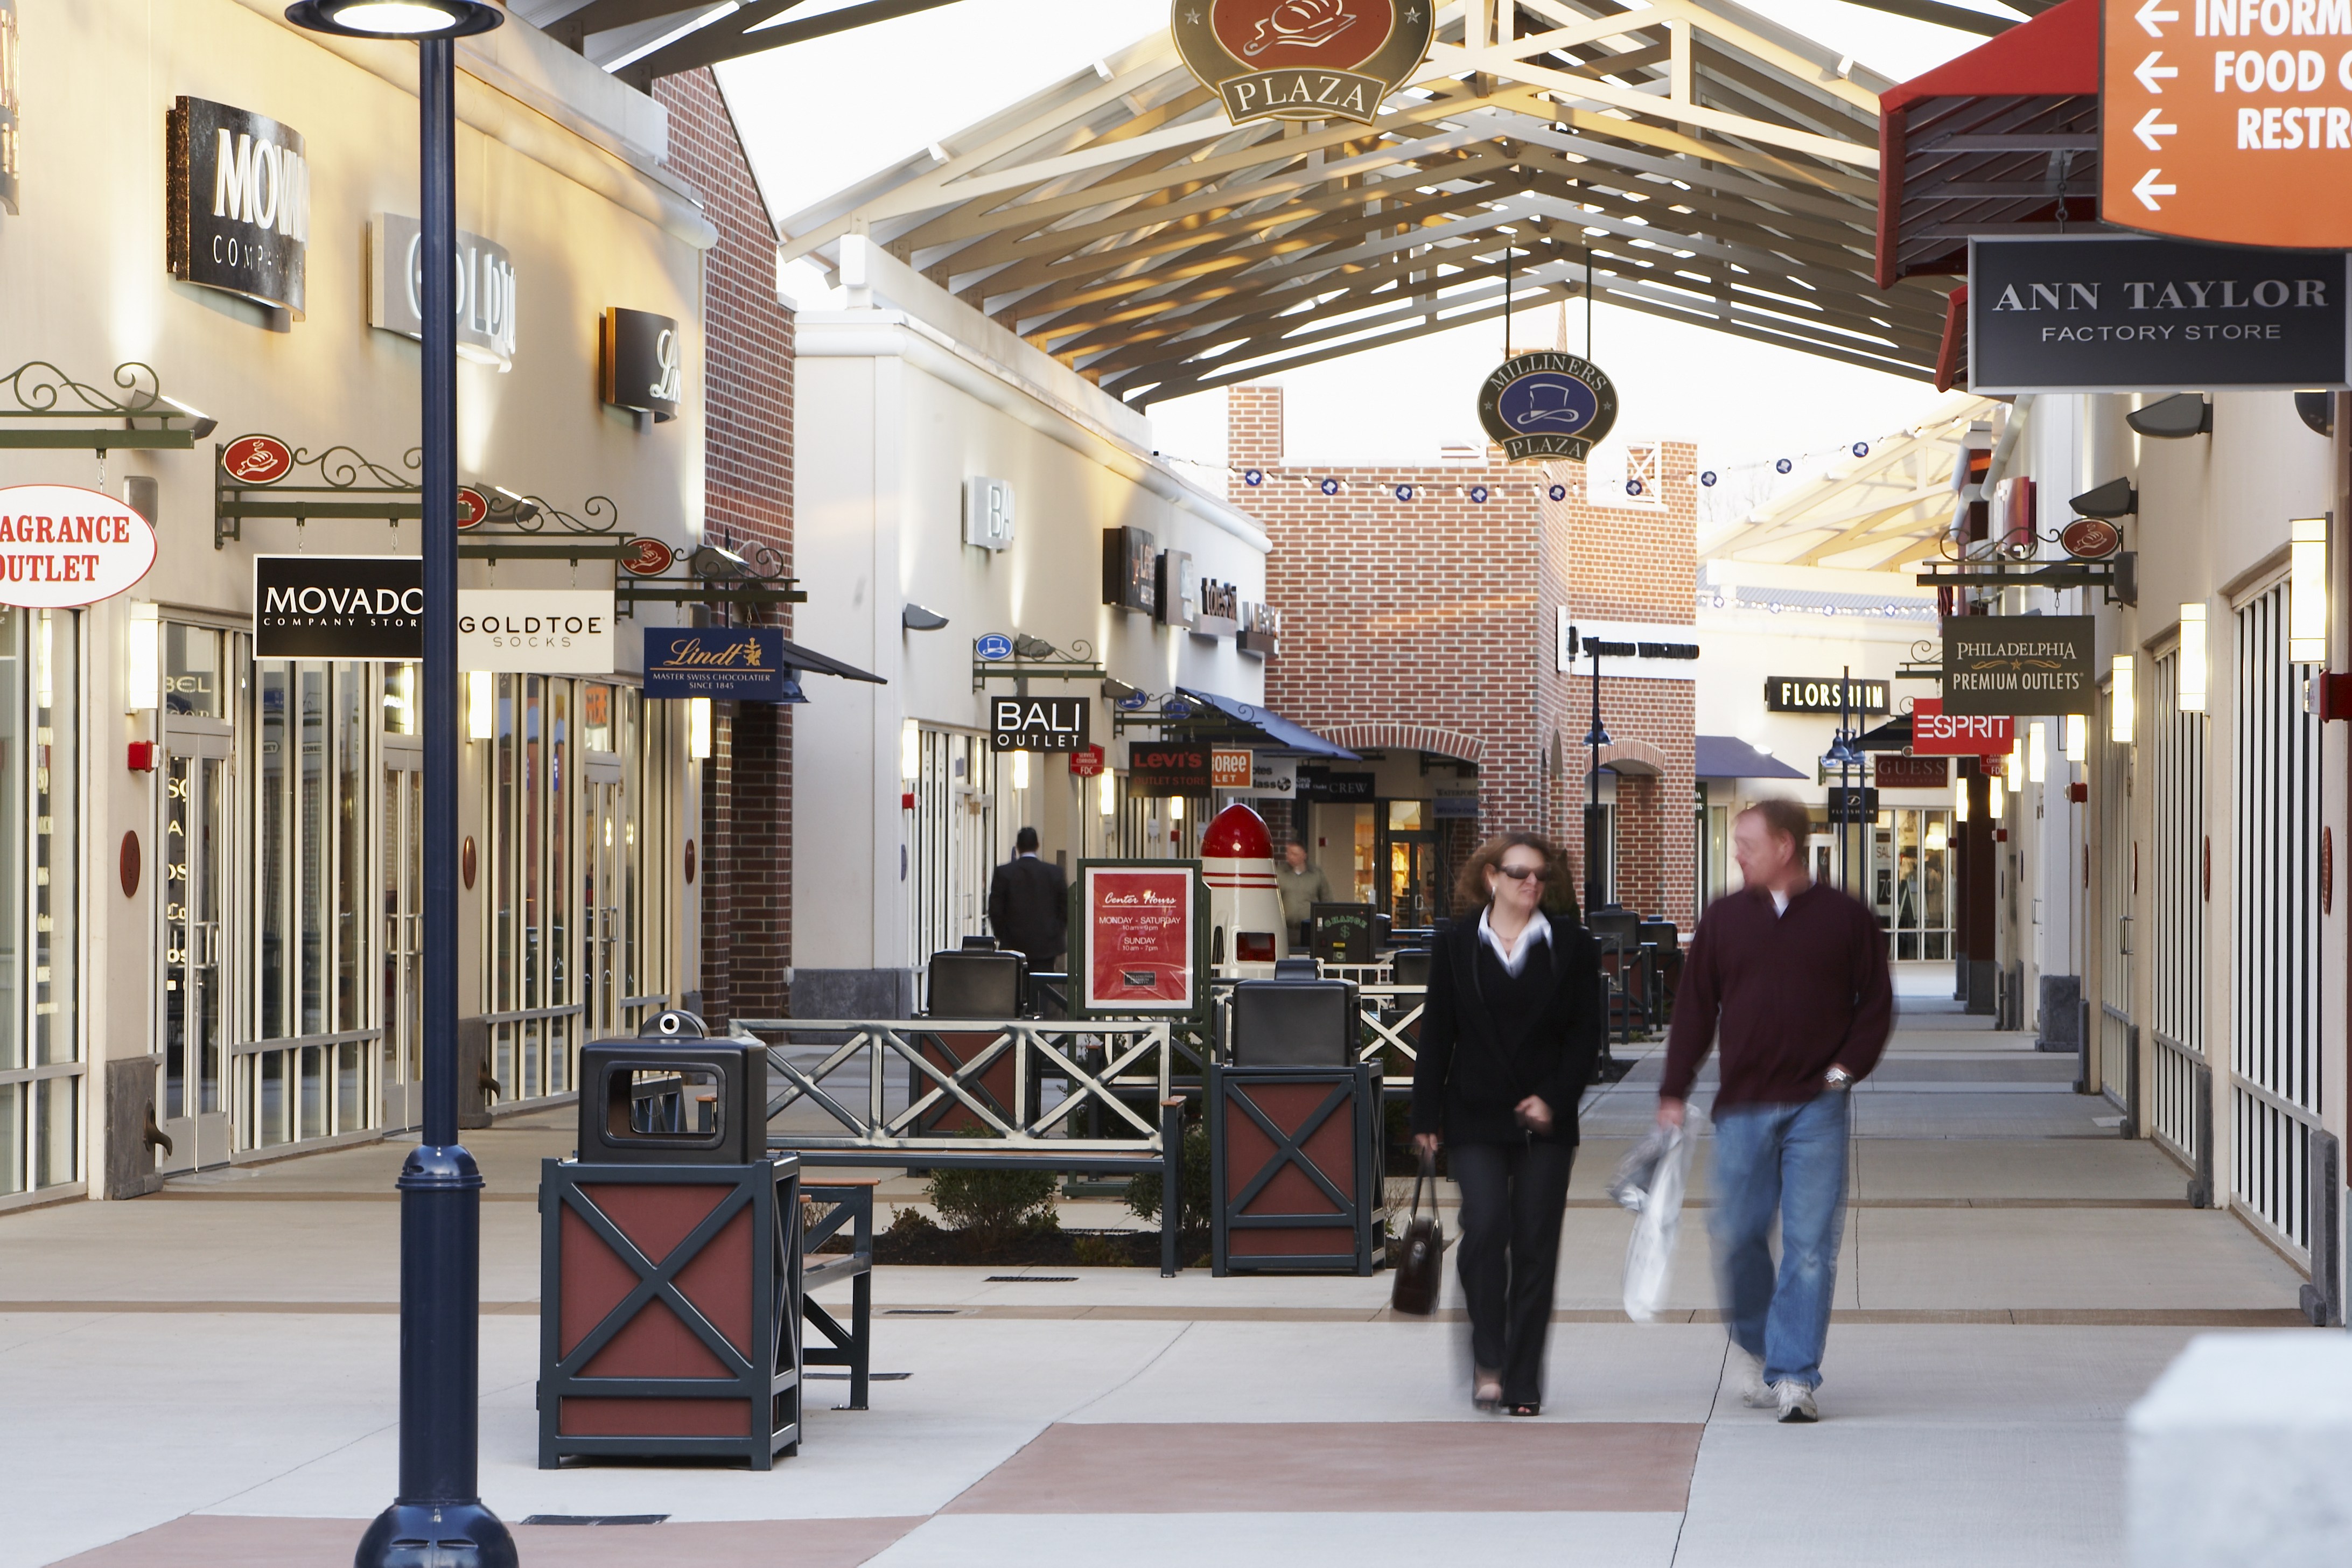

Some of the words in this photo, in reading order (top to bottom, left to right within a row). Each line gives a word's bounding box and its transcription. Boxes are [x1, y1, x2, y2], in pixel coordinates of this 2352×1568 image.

[2215, 50, 2326, 93] FOOD
[1233, 75, 1365, 113] PLAZA
[1992, 282, 2101, 311] ANN
[2124, 279, 2329, 310] TAYLOR
[2042, 325, 2175, 341] FACTORY
[2185, 324, 2281, 340] STORE
[1489, 354, 1607, 391] MILLINERS
[1510, 437, 1581, 458] PLAZA
[0, 515, 130, 543] AGRANCE
[265, 587, 423, 615] MOVADO
[263, 618, 354, 626] COMPANY
[459, 616, 601, 634] GOLDTOE
[493, 636, 571, 647] SOCKS
[663, 638, 744, 666] Lindt
[1956, 642, 2077, 660] PHILADELPHIA
[1953, 673, 2018, 690] PREMIUM
[997, 702, 1080, 732] BALI
[1917, 715, 2010, 738] ESPRIT
[997, 734, 1079, 747] OUTLET
[1080, 766, 1094, 775] FDC
[1878, 760, 1945, 775] GUESS
[1133, 776, 1169, 785] OUTLET
[1172, 776, 1206, 785] STORE
[1329, 783, 1368, 794] CREW
[1105, 892, 1139, 904] Center
[1144, 891, 1177, 905] Hours
[1099, 916, 1133, 925] MONDAY
[1140, 916, 1181, 925] SATURDAY
